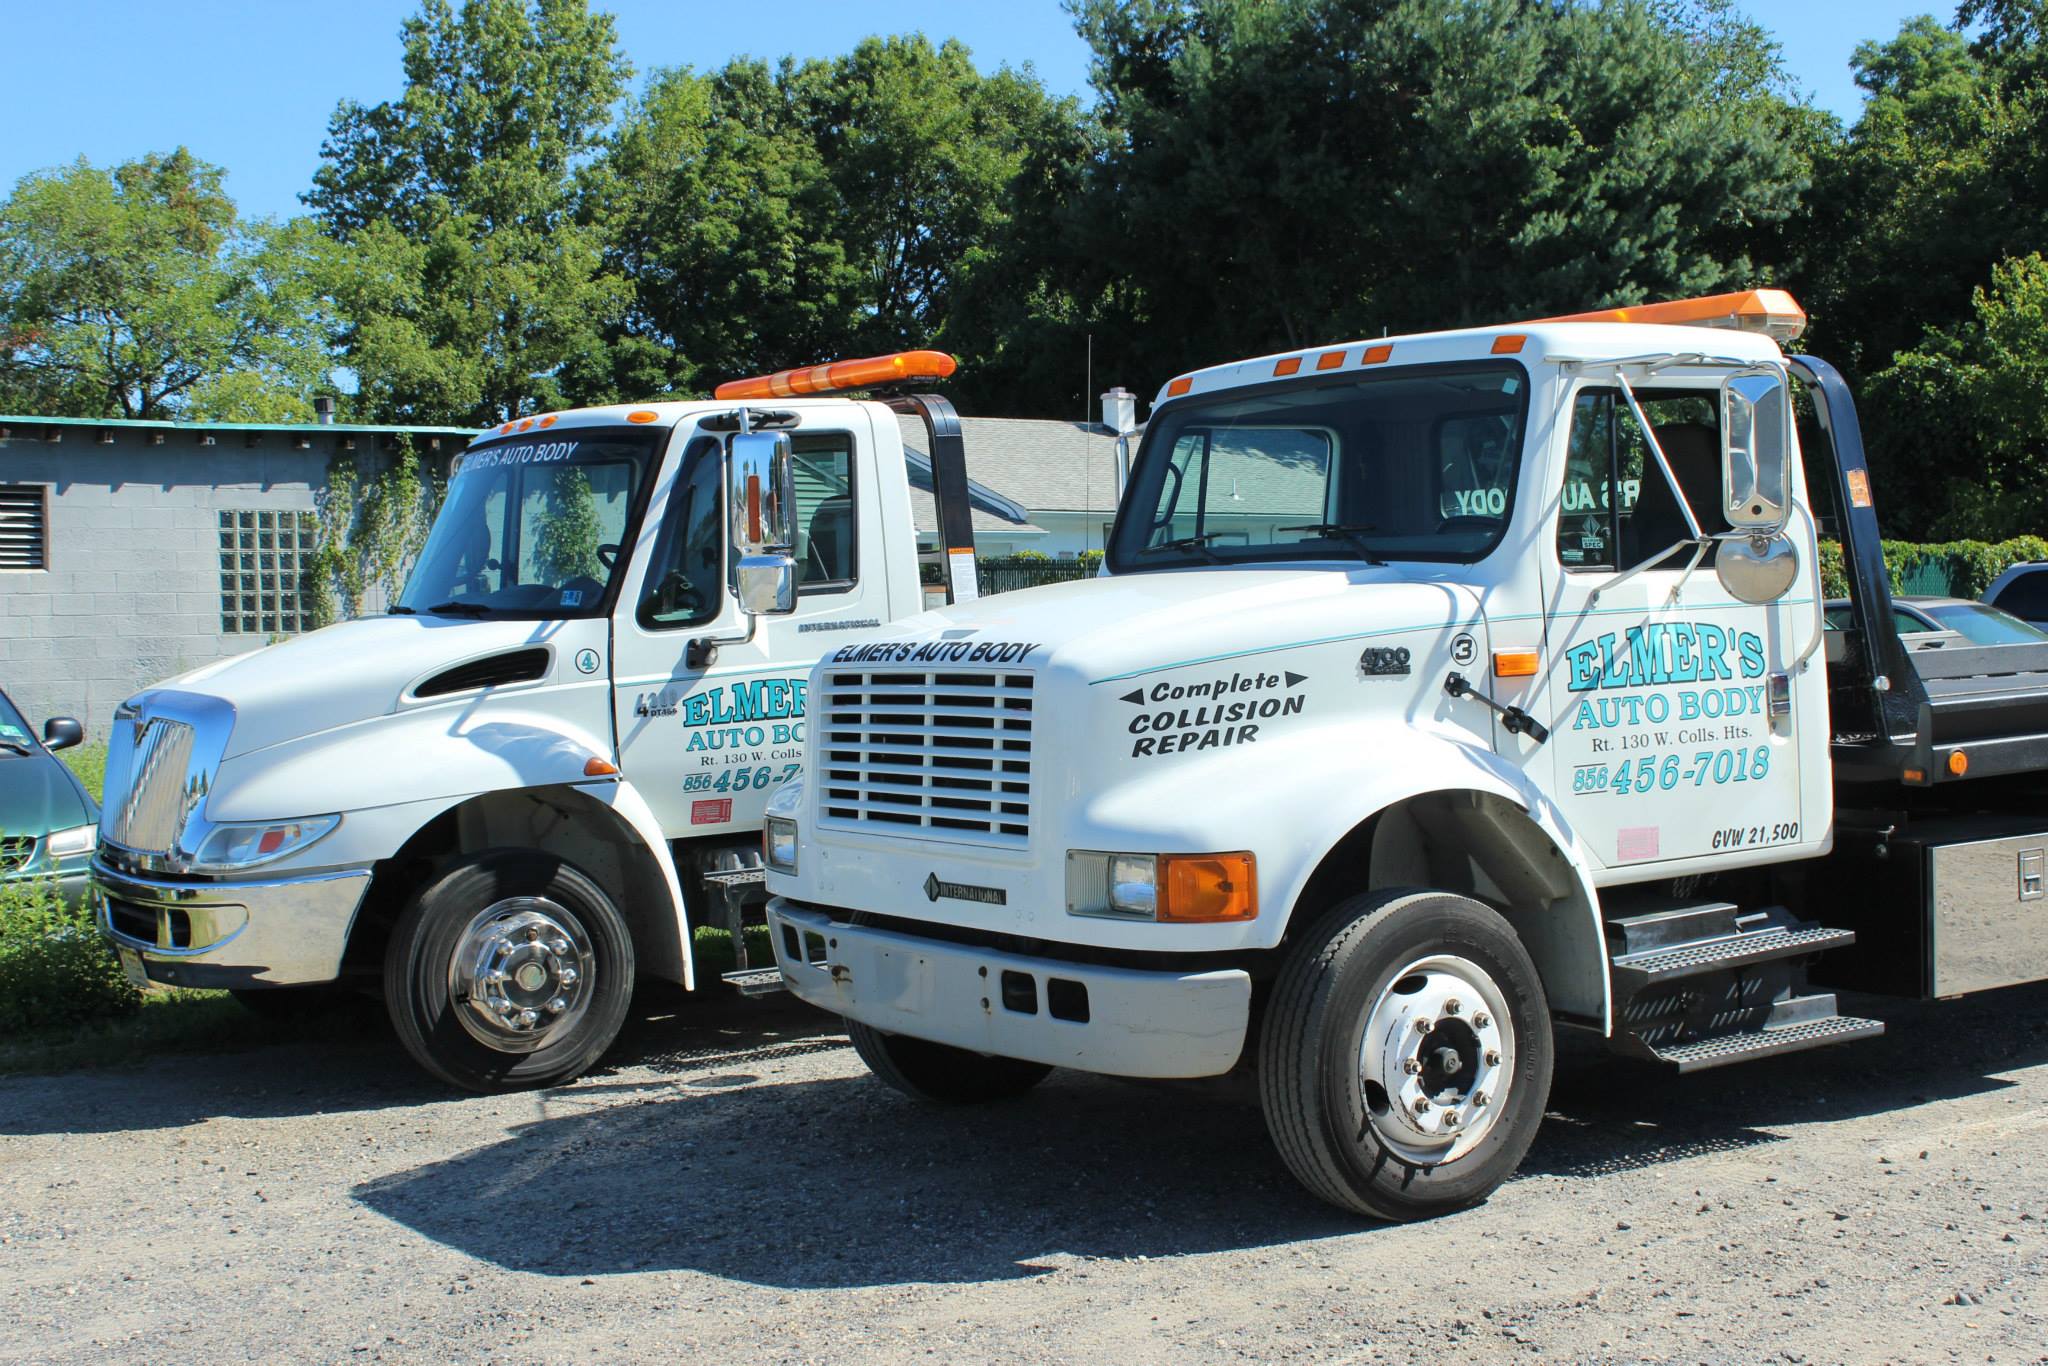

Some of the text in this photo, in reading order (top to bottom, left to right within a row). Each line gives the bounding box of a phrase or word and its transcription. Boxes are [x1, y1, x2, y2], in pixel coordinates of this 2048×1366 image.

[499, 445, 534, 465] AUTO
[533, 441, 579, 462] BODY
[581, 652, 595, 670] 4
[832, 642, 1041, 663] ELMER'S AUTO BODY
[1455, 639, 1472, 660] 3
[1565, 622, 1765, 692] ELMER'S
[1150, 673, 1279, 701] Complete
[1128, 694, 1305, 734] COLLISION
[1573, 686, 1764, 730] AUTO BODY
[686, 726, 765, 752] AUTO
[1132, 725, 1259, 757] REPAIR
[1592, 726, 1752, 752] Rt. 130 W. Colls. Hts.
[701, 756, 718, 766] Rt.
[725, 753, 747, 765] 130
[752, 751, 766, 762] W.
[1573, 746, 1770, 795] 856 456-7018
[683, 774, 712, 791] 856
[1712, 822, 1798, 849] GVW 21,500
[940, 883, 1004, 904] INTERNATIONAL
